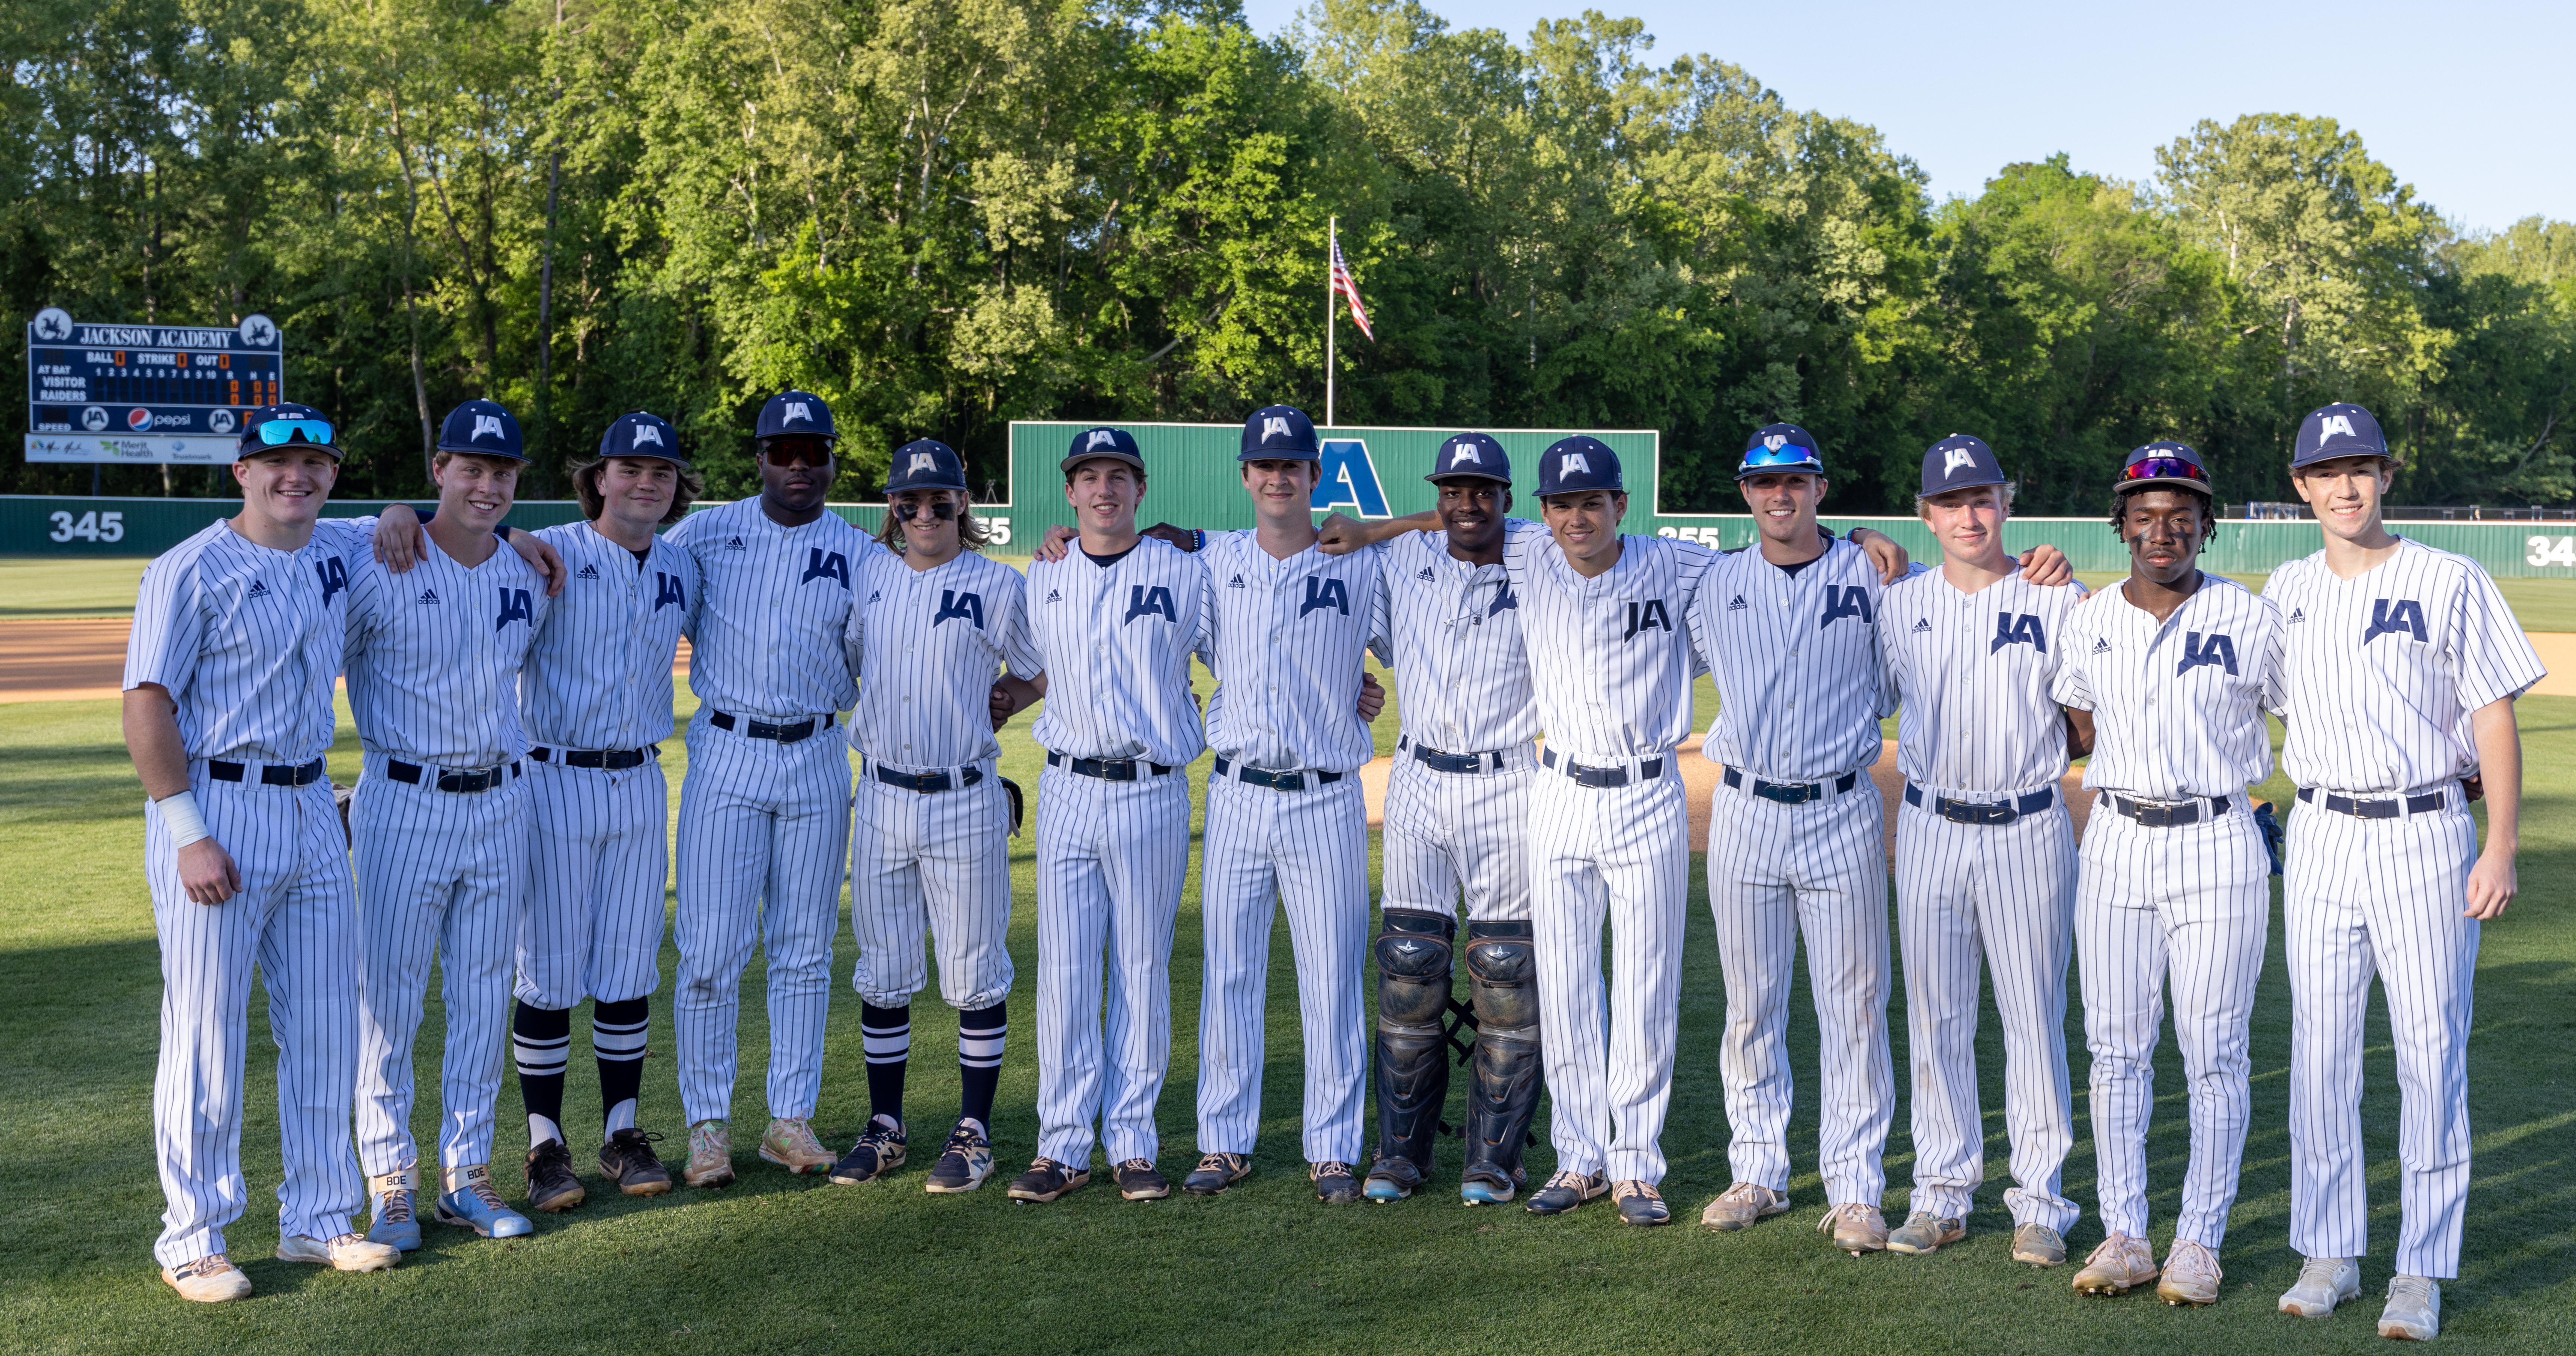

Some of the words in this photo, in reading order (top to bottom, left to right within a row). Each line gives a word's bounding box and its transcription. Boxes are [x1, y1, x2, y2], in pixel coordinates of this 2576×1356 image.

[80, 327, 153, 345] JACKSON
[157, 330, 232, 348] ACADEMY
[38, 365, 51, 374] AT
[52, 365, 71, 375] BAT
[86, 351, 114, 363] BALL
[115, 351, 125, 366] 0
[137, 353, 176, 365] STRIKE
[177, 352, 187, 368] 0
[195, 354, 218, 366] OUT
[219, 353, 230, 369] 0
[42, 376, 86, 388] VISITOR
[95, 367, 101, 376] 1
[108, 367, 115, 377] 2
[121, 368, 127, 377] 3
[133, 368, 140, 377] 4
[146, 368, 152, 378] 5
[158, 369, 165, 378] 6
[171, 369, 178, 378] 7
[183, 370, 190, 379] 8
[195, 370, 202, 379] 9
[206, 370, 217, 379] 10
[226, 371, 234, 380] R
[268, 371, 276, 381] E
[40, 389, 87, 402] RAIDERS
[154, 413, 191, 427] pepsi
[783, 402, 813, 428] JA
[38, 423, 71, 431] SPEED
[471, 415, 505, 442] JA
[633, 425, 664, 450] JA
[1261, 417, 1293, 445] JA
[2320, 415, 2356, 448] JA
[121, 440, 147, 449] Merit
[1086, 430, 1116, 452] JA
[121, 449, 153, 458] Health
[1451, 443, 1482, 470] JA
[1944, 448, 1977, 480] JA
[907, 453, 938, 478] JA
[1559, 453, 1591, 483] JA
[1310, 438, 1393, 519] A
[50, 510, 124, 543] 345
[2527, 535, 2576, 567] 34
[249, 590, 270, 598] adidas
[1473, 617, 1481, 625] 30
[1623, 599, 1674, 646] JA
[529, 1149, 541, 1162] NIKE
[387, 1175, 406, 1186] BDE
[467, 1167, 485, 1180] BDE
